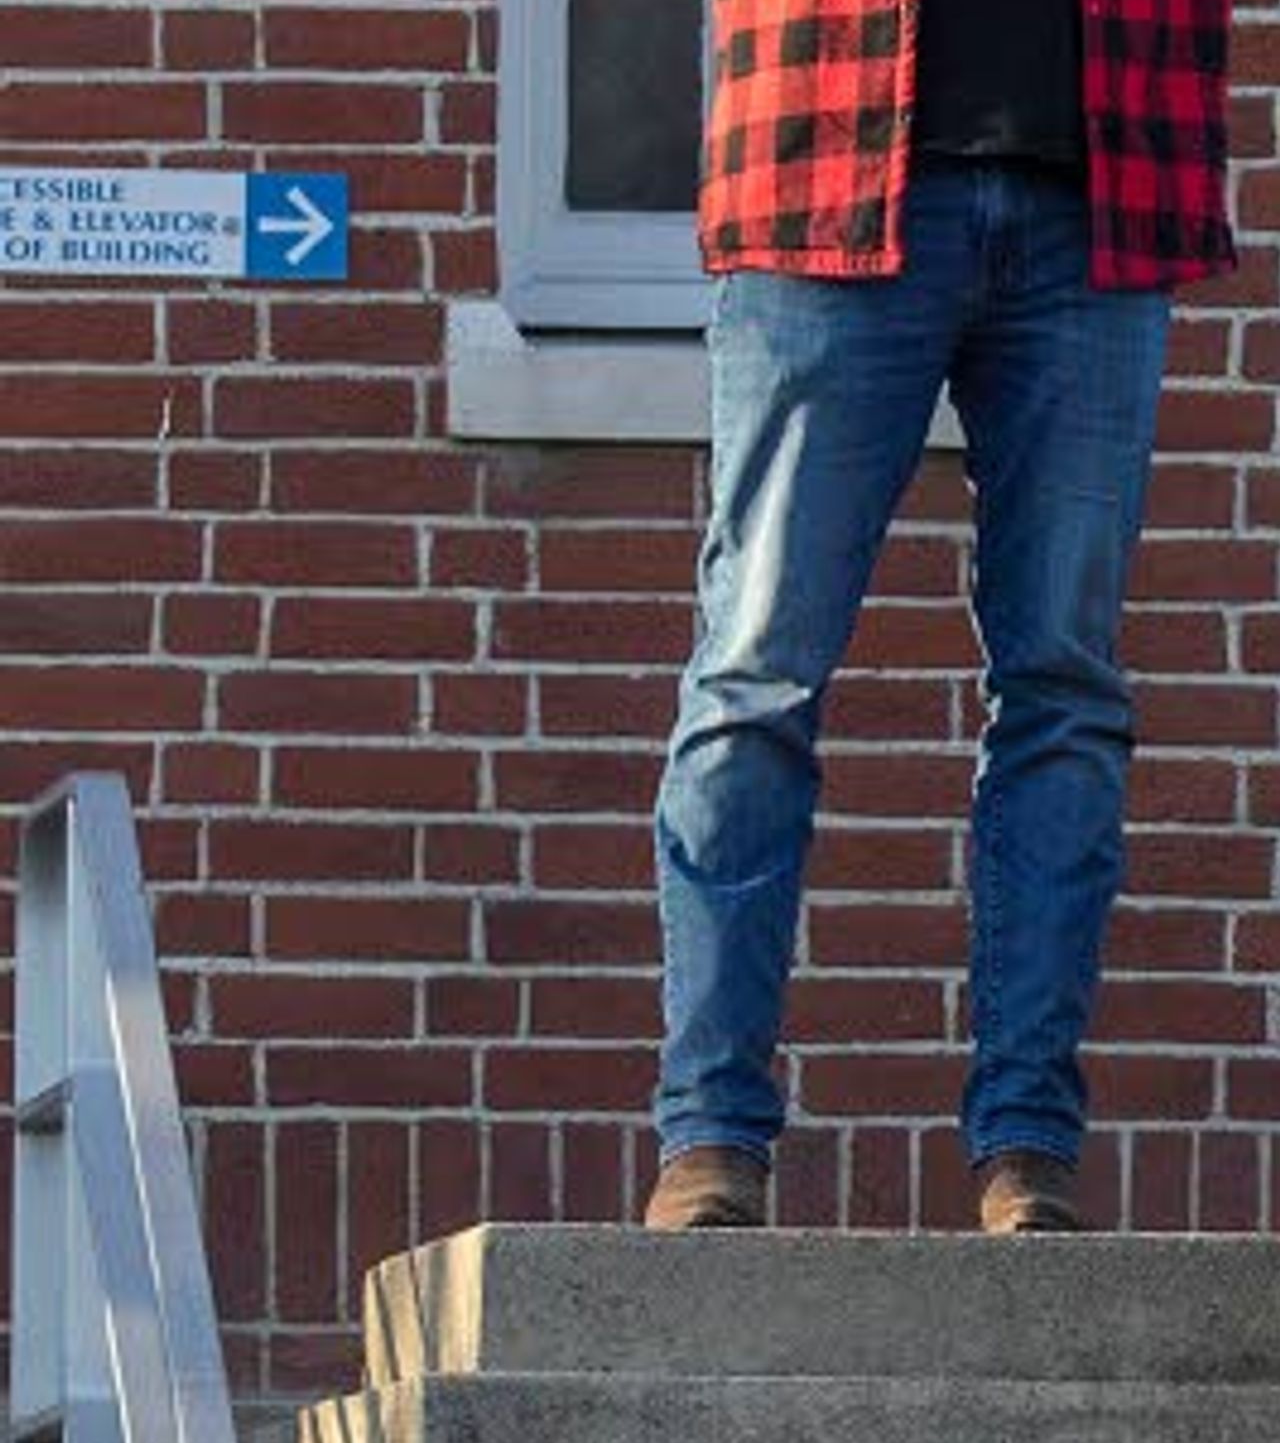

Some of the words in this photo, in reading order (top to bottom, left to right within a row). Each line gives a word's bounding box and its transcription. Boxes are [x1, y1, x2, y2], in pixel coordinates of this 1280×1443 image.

[32, 209, 54, 231] &
[69, 211, 218, 236] ELEVATOR
[4, 235, 48, 261] OF
[62, 239, 210, 265] BUILDING
